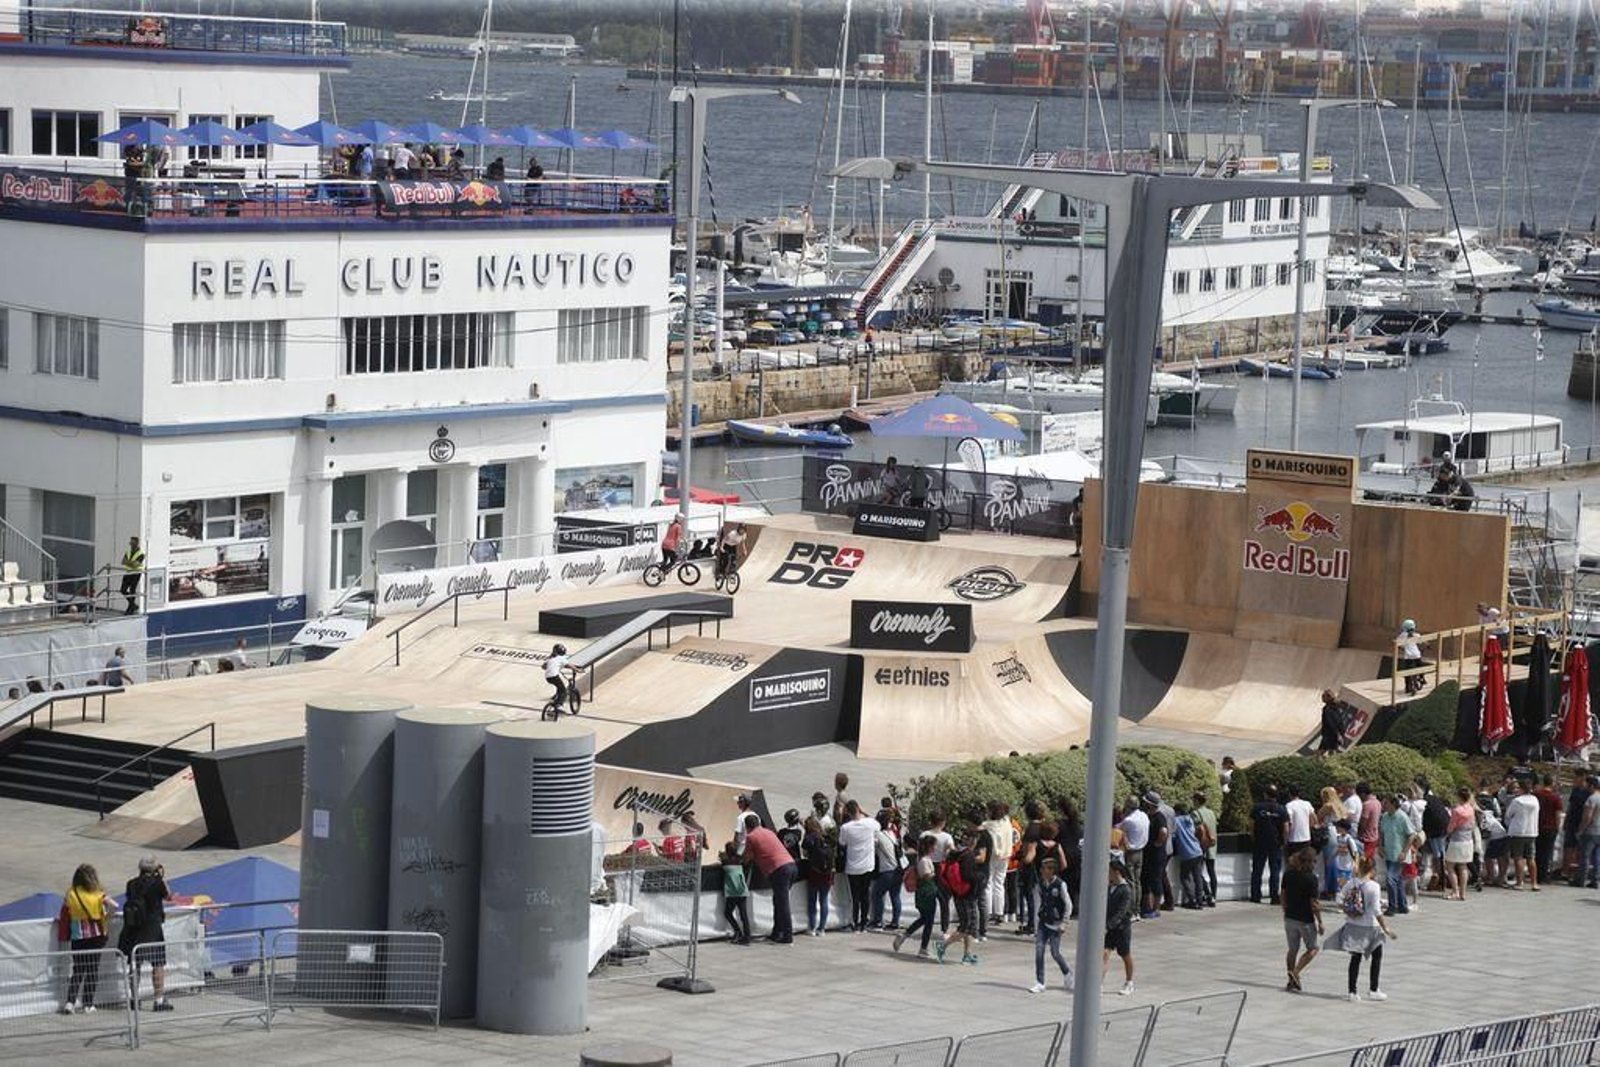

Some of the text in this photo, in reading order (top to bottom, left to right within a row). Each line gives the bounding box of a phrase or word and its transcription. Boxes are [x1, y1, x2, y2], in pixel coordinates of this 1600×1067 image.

[192, 252, 634, 300] REAL CLUB NAUTICO
[1252, 458, 1261, 469] O
[860, 514, 868, 522] O
[1244, 540, 1350, 581] Red Bull
[767, 562, 855, 589] DG
[869, 606, 956, 645] Cromoly
[893, 666, 950, 687] etnies
[754, 686, 763, 699] O
